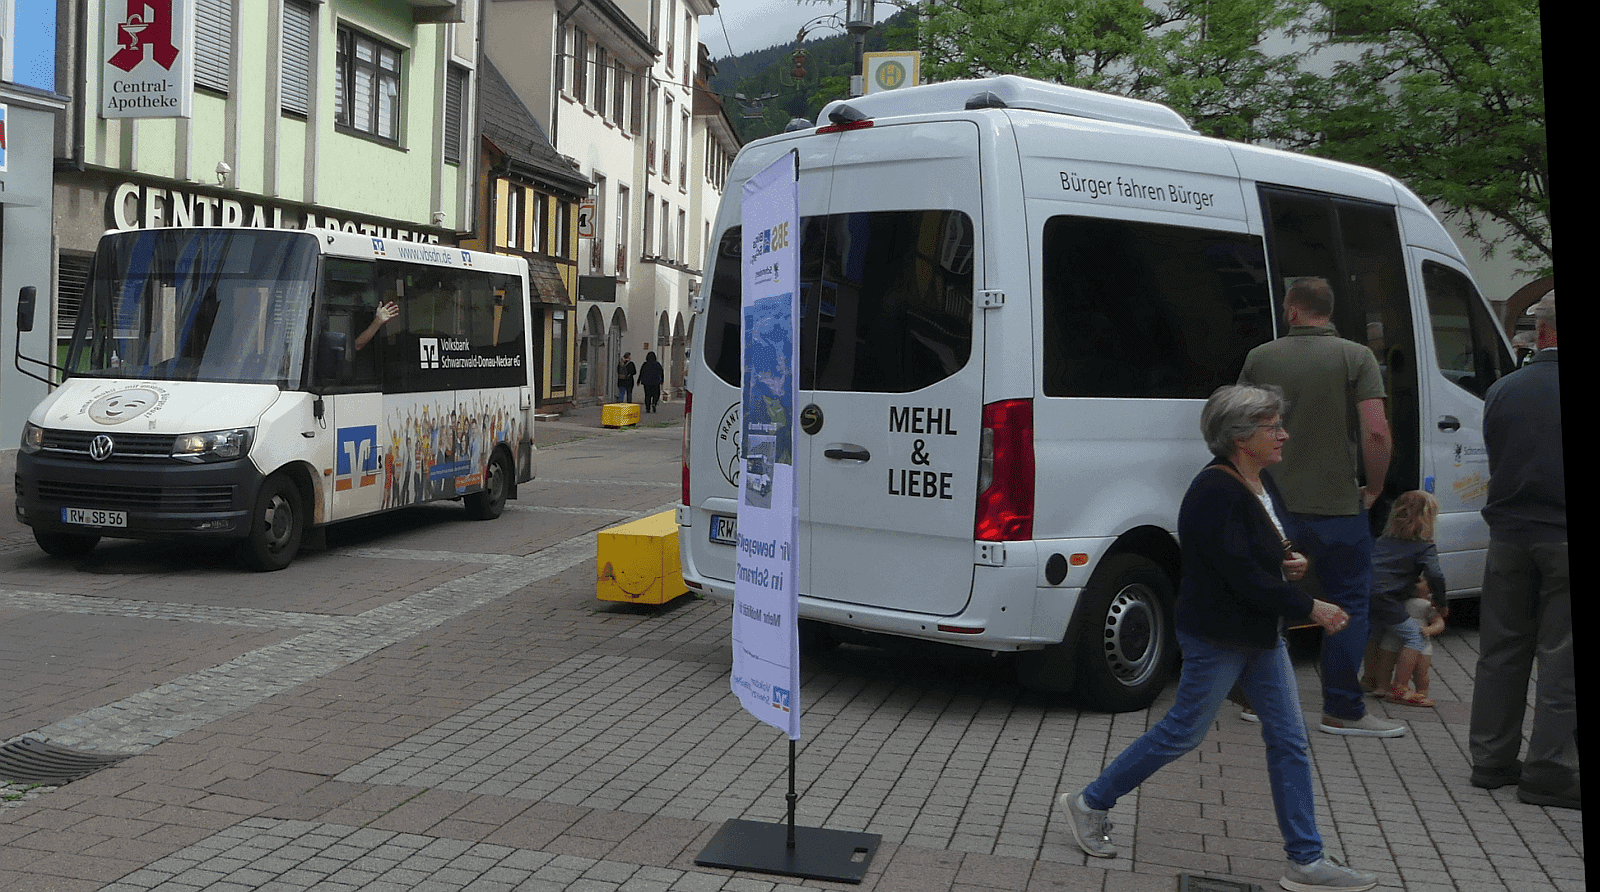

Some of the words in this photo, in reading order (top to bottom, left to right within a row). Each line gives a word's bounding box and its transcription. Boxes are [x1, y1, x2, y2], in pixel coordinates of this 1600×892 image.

[113, 79, 173, 93] Central-
[107, 95, 177, 111] Apotheke
[1060, 172, 1112, 199] Bürger
[1116, 177, 1166, 201] fahren
[1168, 184, 1214, 210] Bürger
[398, 246, 452, 264] www.vbsdn.de
[440, 338, 470, 351] Volksbank
[441, 354, 513, 369] Schwarzwald-Donau-Neckar
[889, 406, 957, 435] MEHL
[911, 439, 930, 465] &
[888, 468, 953, 500] LIEBE
[70, 509, 85, 522] RW
[92, 511, 106, 524] SB
[108, 512, 123, 525] 56
[717, 519, 735, 538] RW
